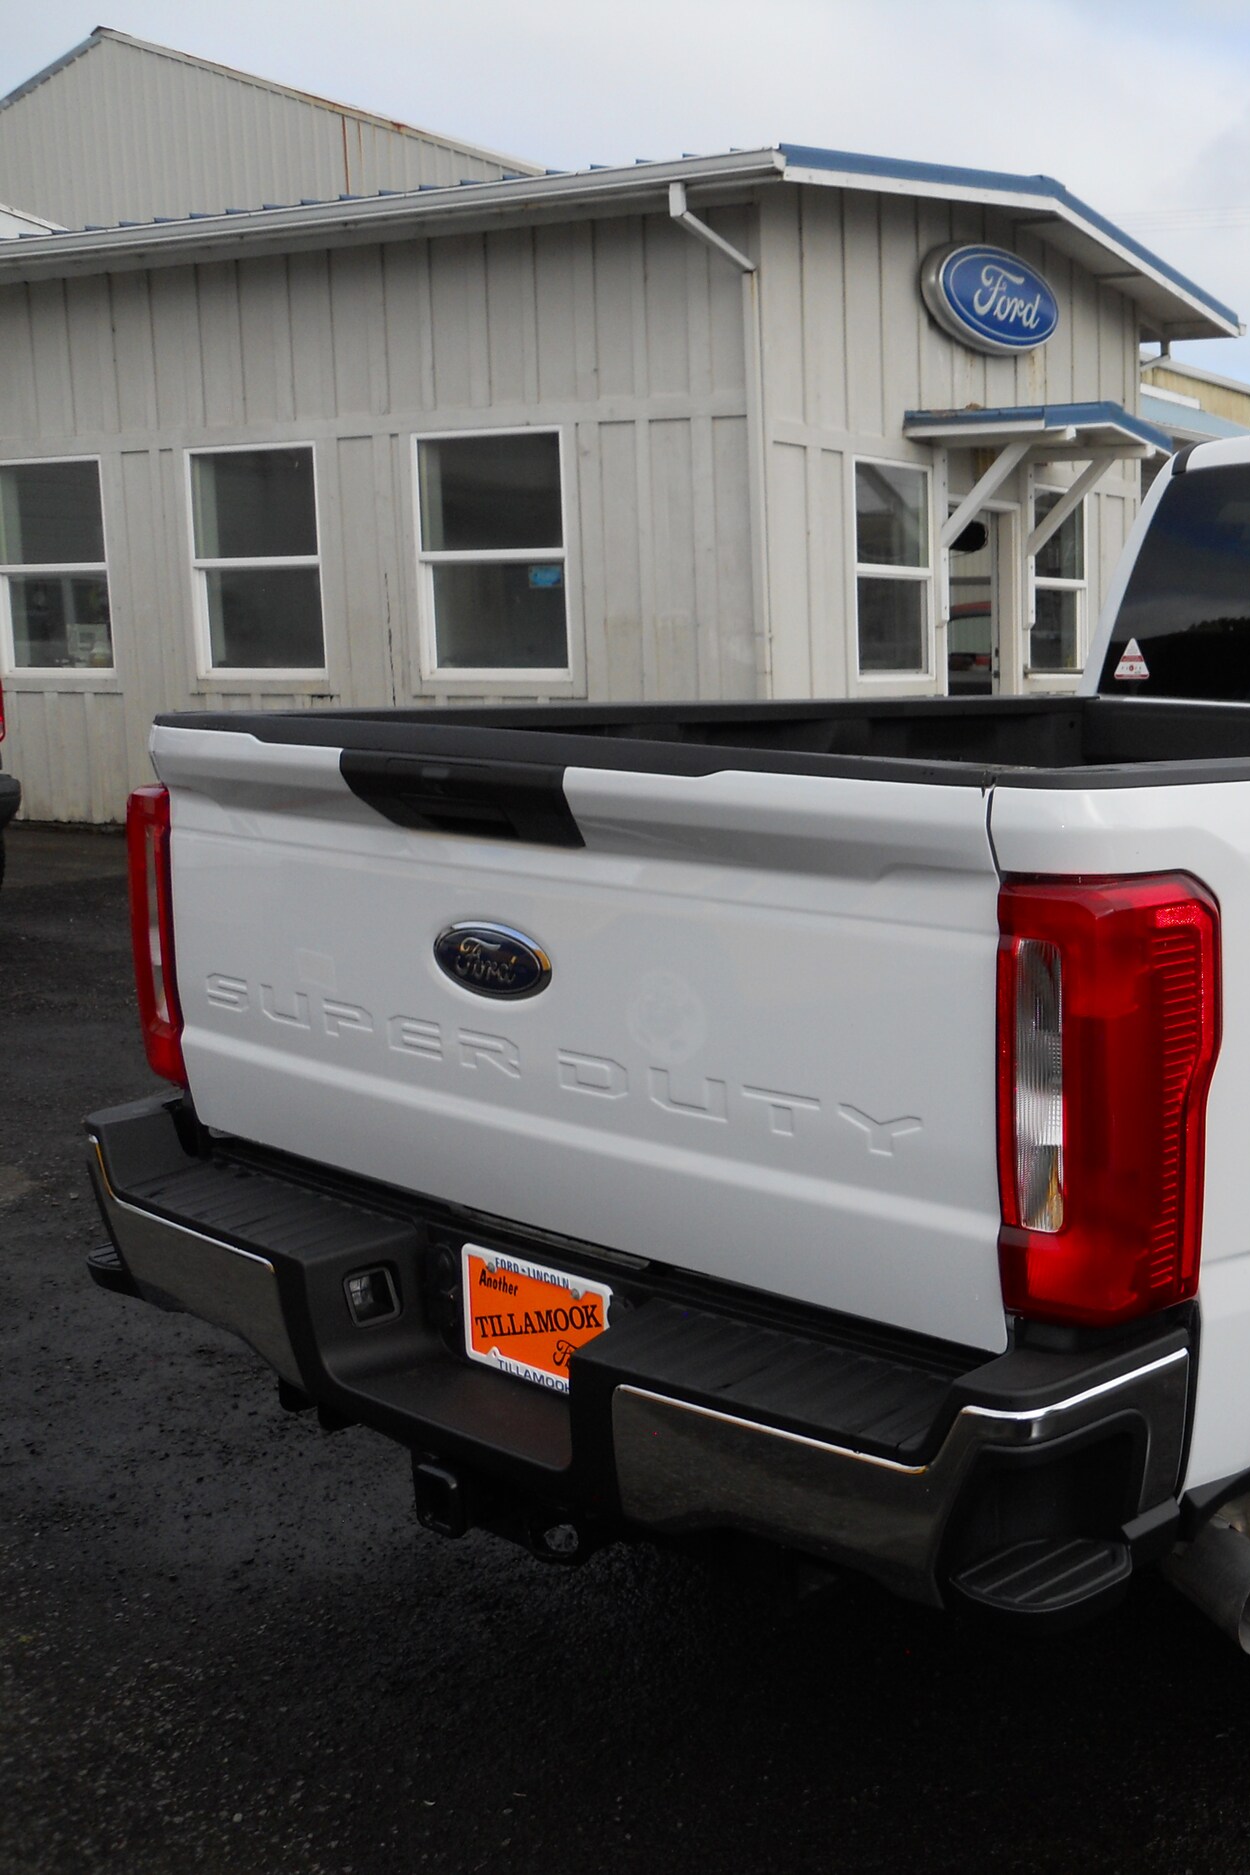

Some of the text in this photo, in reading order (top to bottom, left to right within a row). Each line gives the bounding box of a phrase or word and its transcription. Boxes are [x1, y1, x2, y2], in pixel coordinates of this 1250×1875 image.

[973, 264, 1041, 329] Ford
[455, 936, 517, 985] Ford
[206, 971, 925, 1157] SUPER DUTY
[479, 1269, 519, 1297] Another
[475, 1304, 602, 1338] TILLAMOOK
